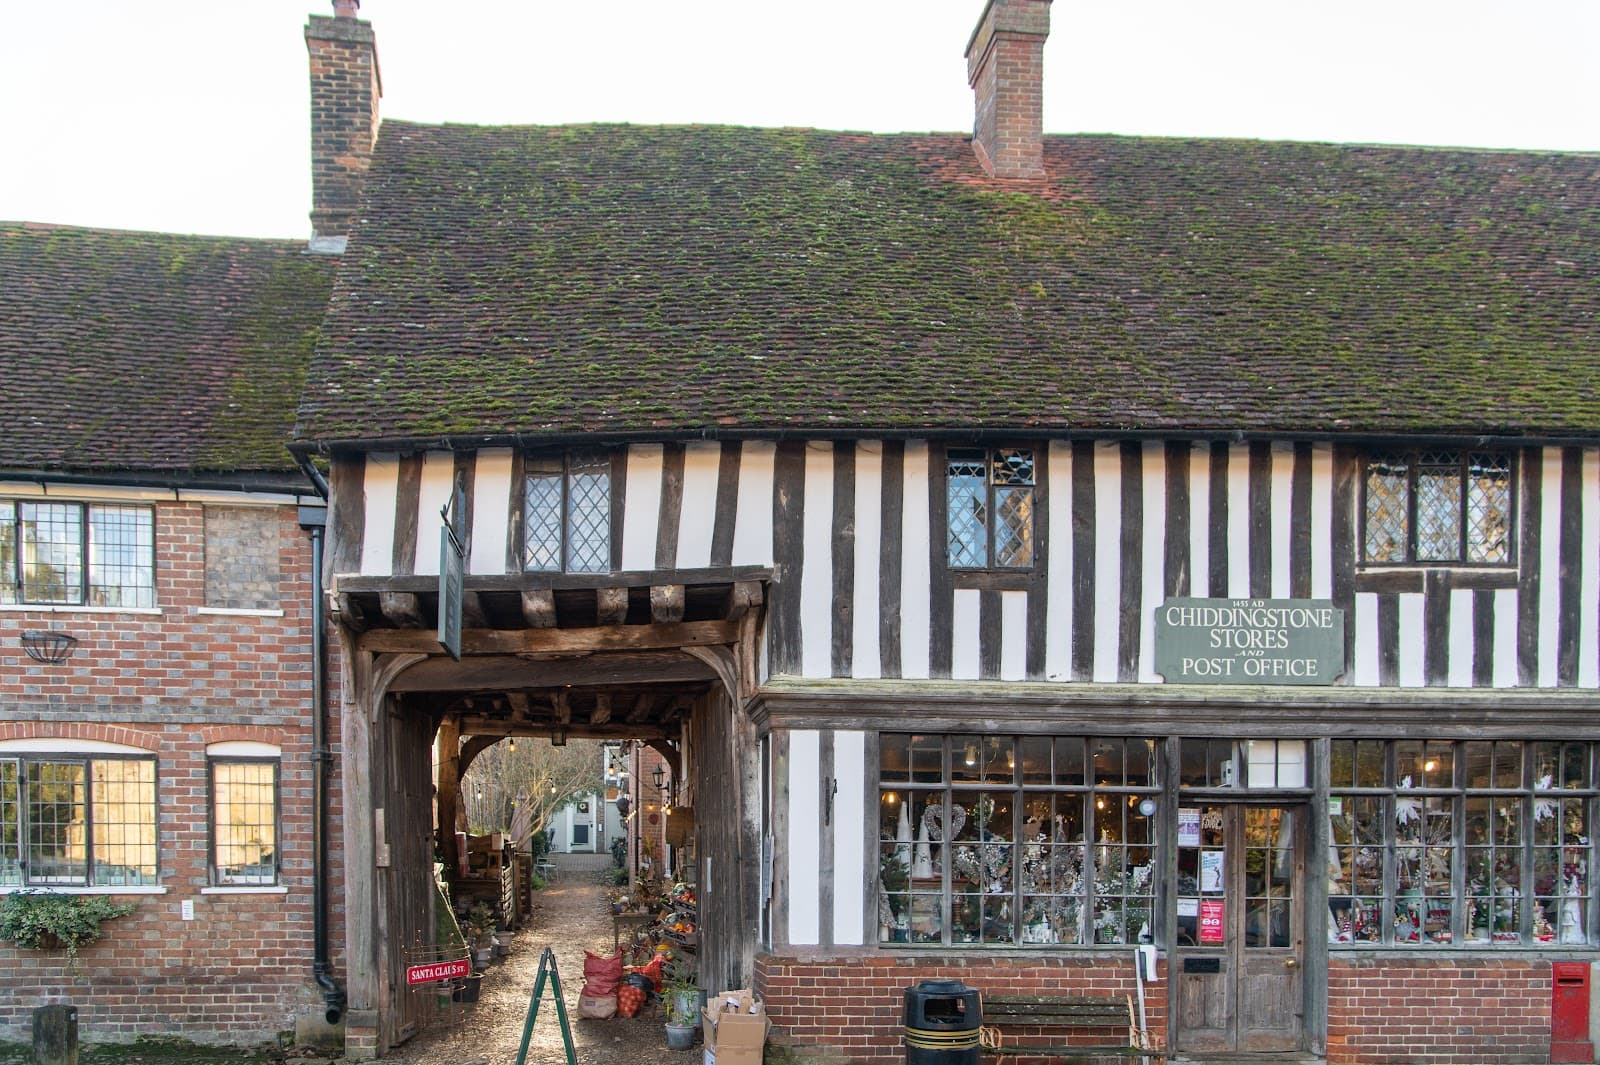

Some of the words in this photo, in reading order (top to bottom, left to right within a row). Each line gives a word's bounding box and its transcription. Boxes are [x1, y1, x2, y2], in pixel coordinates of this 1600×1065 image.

[1251, 600, 1265, 608] AD
[1166, 607, 1333, 628] CHIDDINGSTONE
[1210, 629, 1289, 649] STORES
[1182, 658, 1236, 676] POST
[1243, 658, 1319, 677] OFFICE
[411, 968, 434, 980] SANTA
[435, 965, 457, 976] CLAUS
